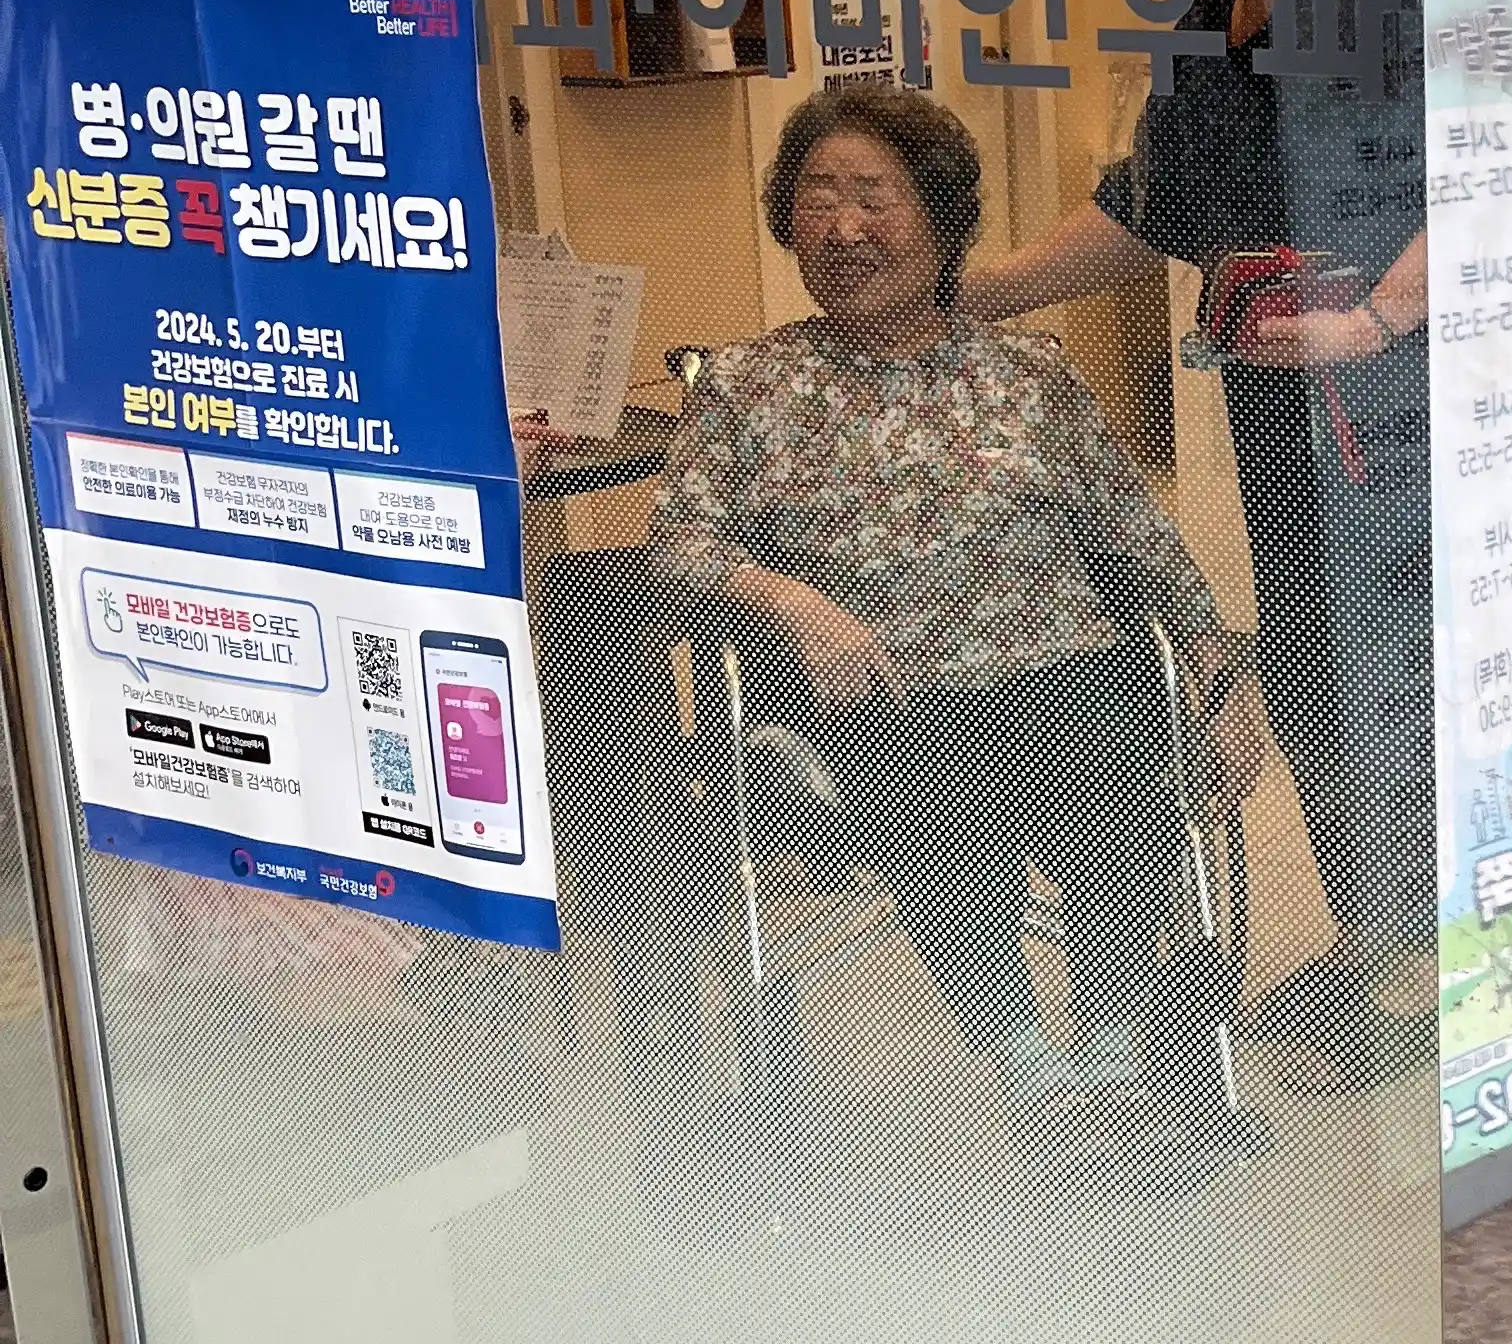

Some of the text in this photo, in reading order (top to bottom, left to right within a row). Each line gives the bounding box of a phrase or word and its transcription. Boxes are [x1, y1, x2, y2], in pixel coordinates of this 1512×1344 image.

[376, 15, 416, 36] Better
[71, 81, 387, 177] 병·의원 갈 땐
[27, 167, 469, 271] 신분증 꼭 챙기세요!
[156, 310, 345, 362] 2024. 5. 20.부터
[151, 350, 359, 404] 건강보험으로 진료 시
[123, 383, 400, 455] 본인 여부를 확인합니다.
[83, 476, 181, 504] 안전한 의료이용 가능
[216, 470, 309, 497] 건강보험 무자격자의
[203, 487, 328, 518] 부정수급 차단하여 건강보험
[377, 490, 436, 512] 건강보험증
[227, 507, 309, 534] 재정의 누수 방지
[435, 517, 459, 534] 인한
[352, 524, 471, 554] 약물 오남용 사전 예방
[126, 593, 300, 639] 모바일 건강보험증으로도
[136, 621, 298, 666] 본인확인이 가능합니다.
[177, 696, 197, 713] 또는
[199, 701, 277, 727] App스토어에서
[144, 721, 189, 741] Google Play
[215, 732, 230, 745] App
[132, 771, 210, 800] 설치해보세요!
[246, 772, 301, 796] 검색하여
[256, 861, 307, 883] 보건복지부
[319, 873, 378, 900] 국민건강보험
